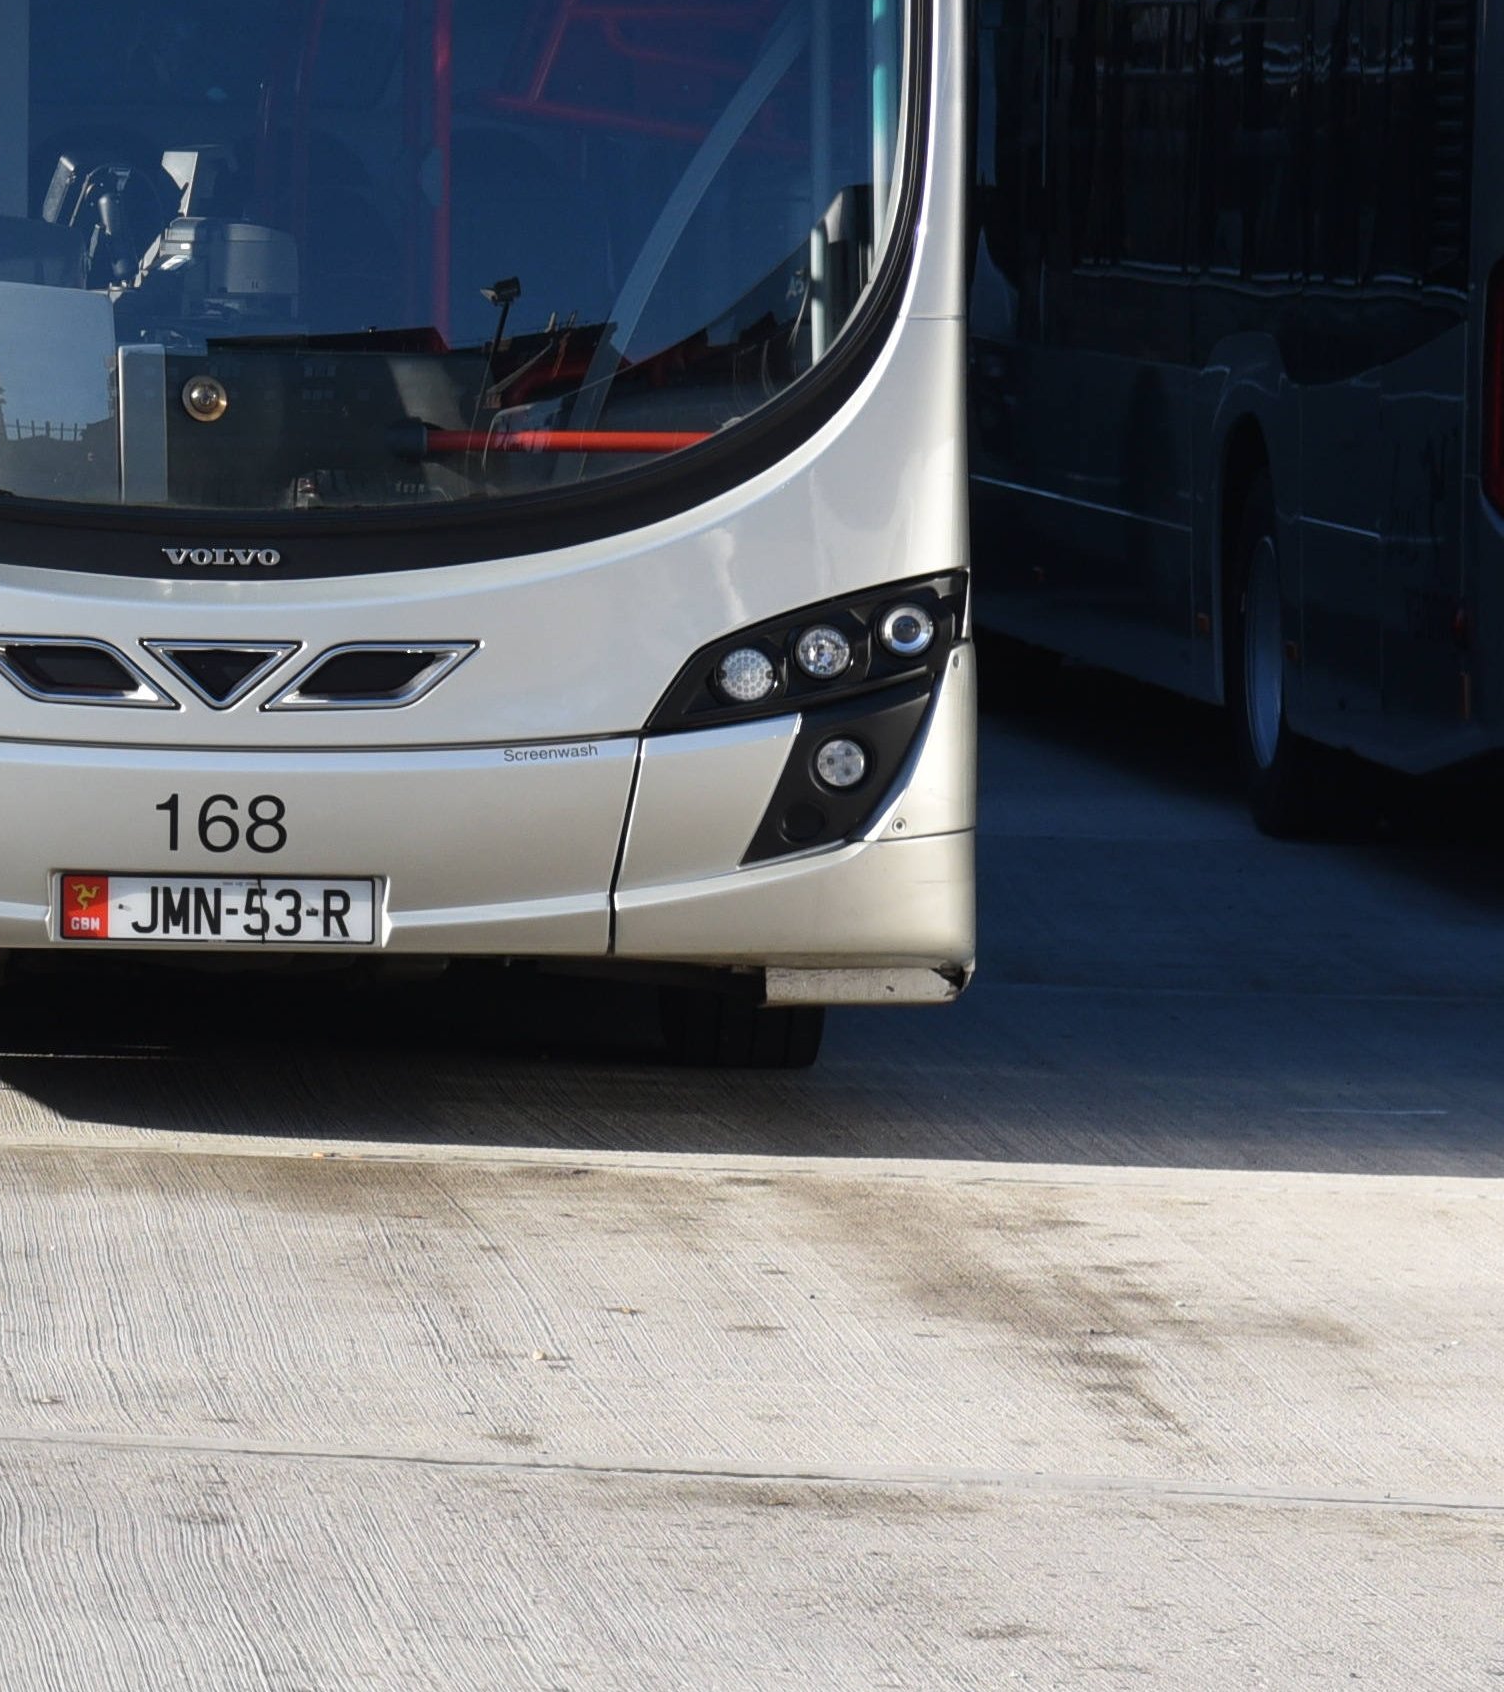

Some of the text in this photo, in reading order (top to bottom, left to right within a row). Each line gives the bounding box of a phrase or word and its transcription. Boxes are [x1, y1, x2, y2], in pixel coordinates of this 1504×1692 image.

[164, 547, 280, 567] VOLVO
[503, 743, 599, 763] Screenwash
[155, 792, 289, 854] 168
[131, 886, 351, 938] JMN-53-R
[70, 916, 102, 932] GBM
